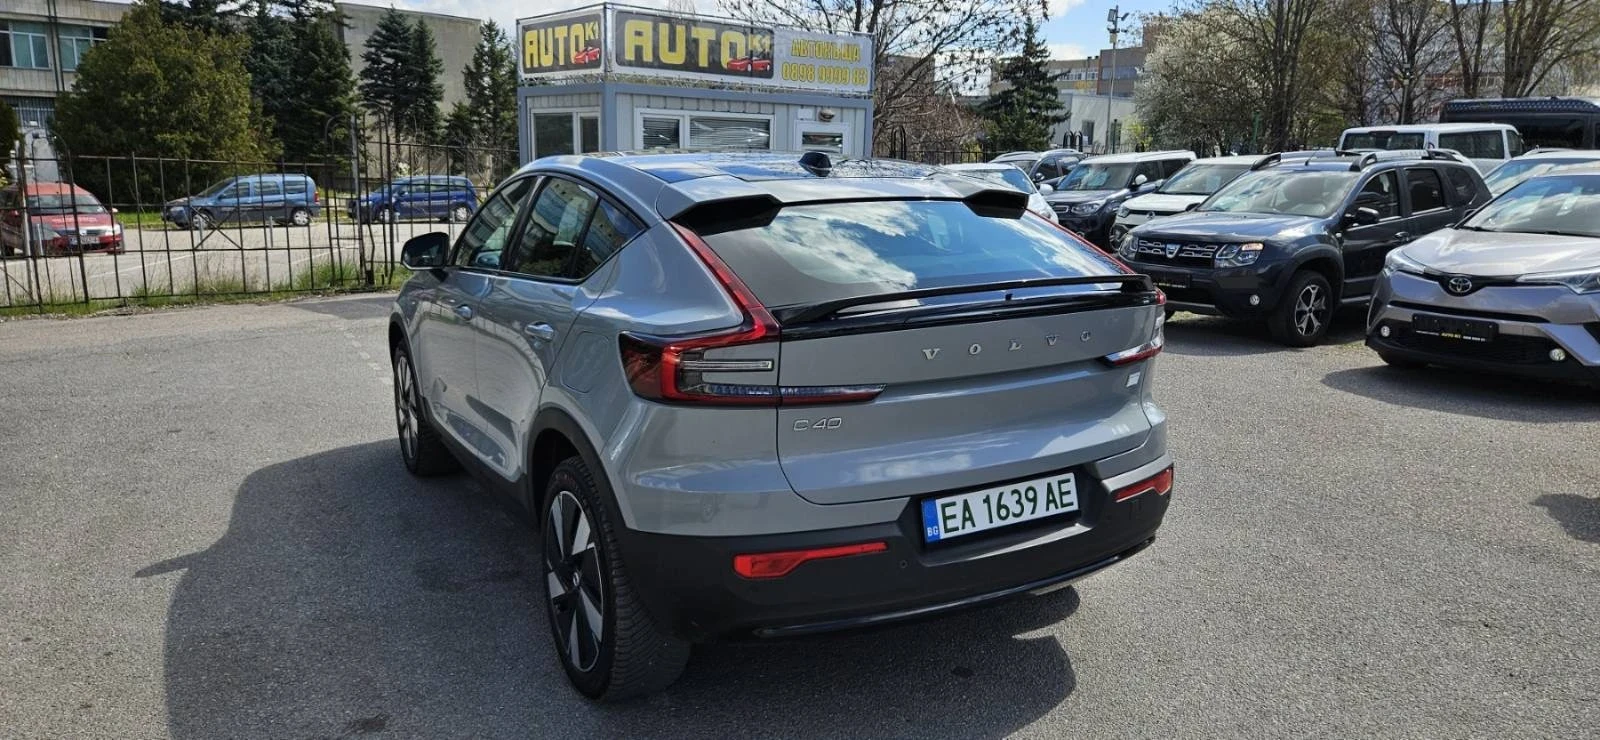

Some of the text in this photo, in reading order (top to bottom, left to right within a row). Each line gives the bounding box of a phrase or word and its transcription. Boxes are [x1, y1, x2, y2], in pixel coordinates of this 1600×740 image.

[525, 23, 584, 69] AUTO
[624, 19, 746, 69] AUTO
[922, 330, 1091, 360] VOLVO
[940, 478, 1074, 534] EA 1639 AE
[926, 526, 939, 537] BG
